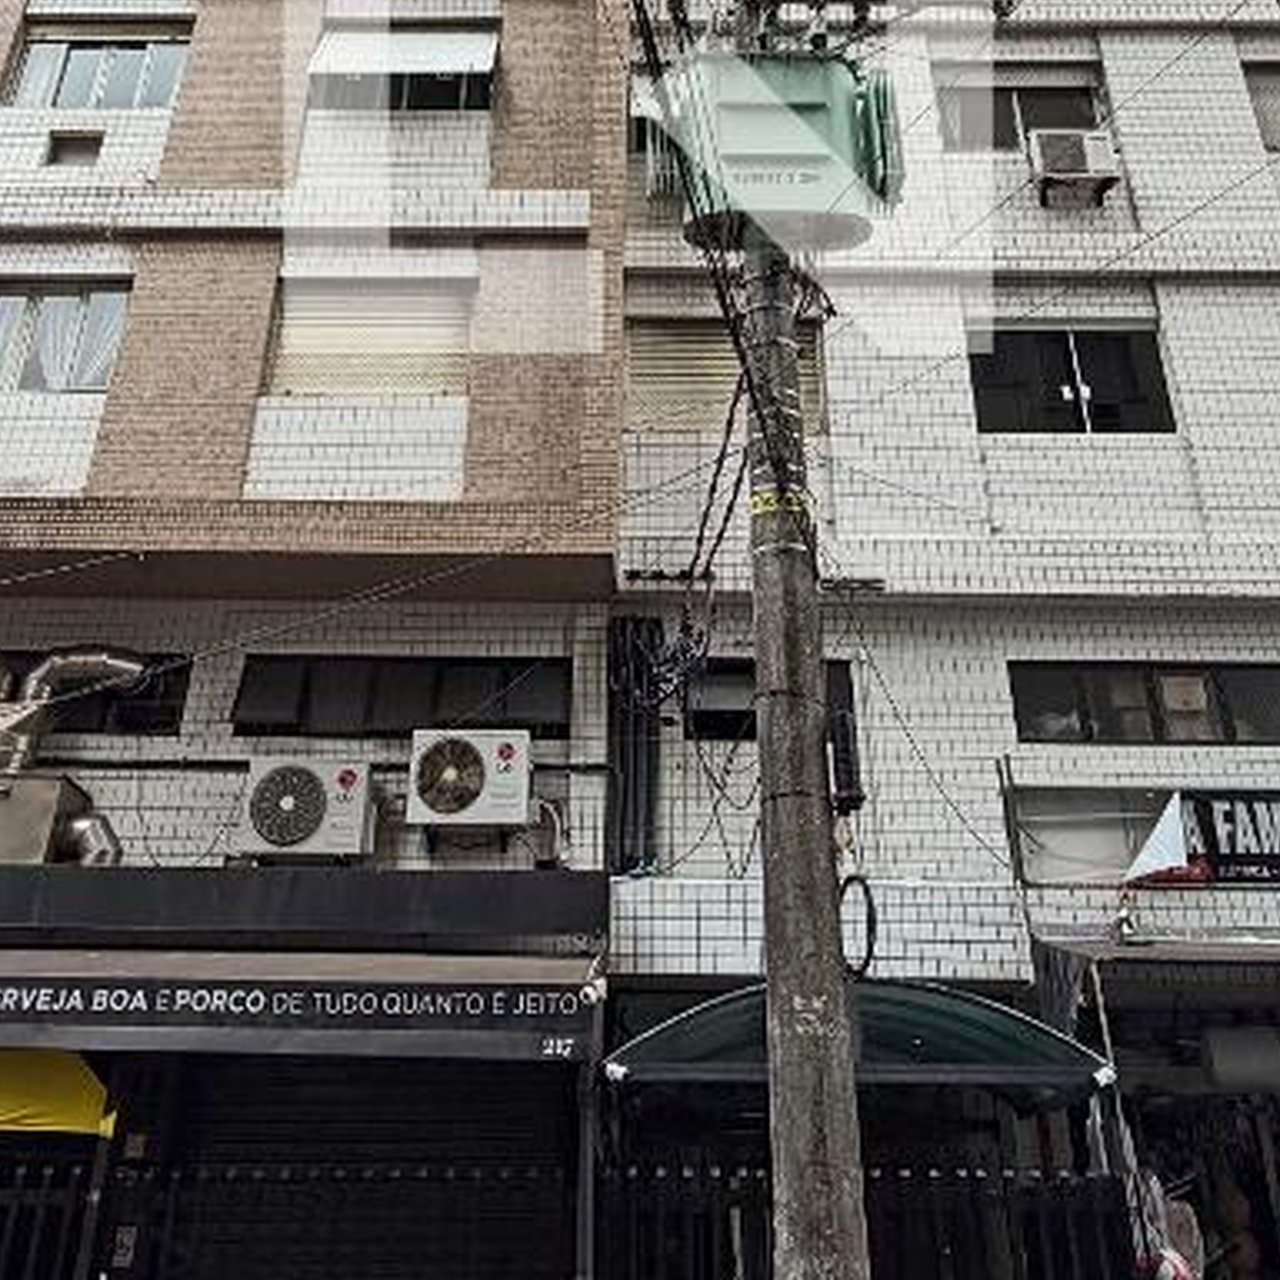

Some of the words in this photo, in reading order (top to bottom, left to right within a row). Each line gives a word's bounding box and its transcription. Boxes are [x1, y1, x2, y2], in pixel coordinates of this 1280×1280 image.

[90, 988, 148, 1012] BOA
[155, 990, 170, 1012] E
[173, 989, 266, 1014] PORCO
[272, 992, 304, 1014] DE
[314, 992, 378, 1015] TUDO
[382, 992, 484, 1016] QUANTO
[513, 993, 578, 1015] JEITO
